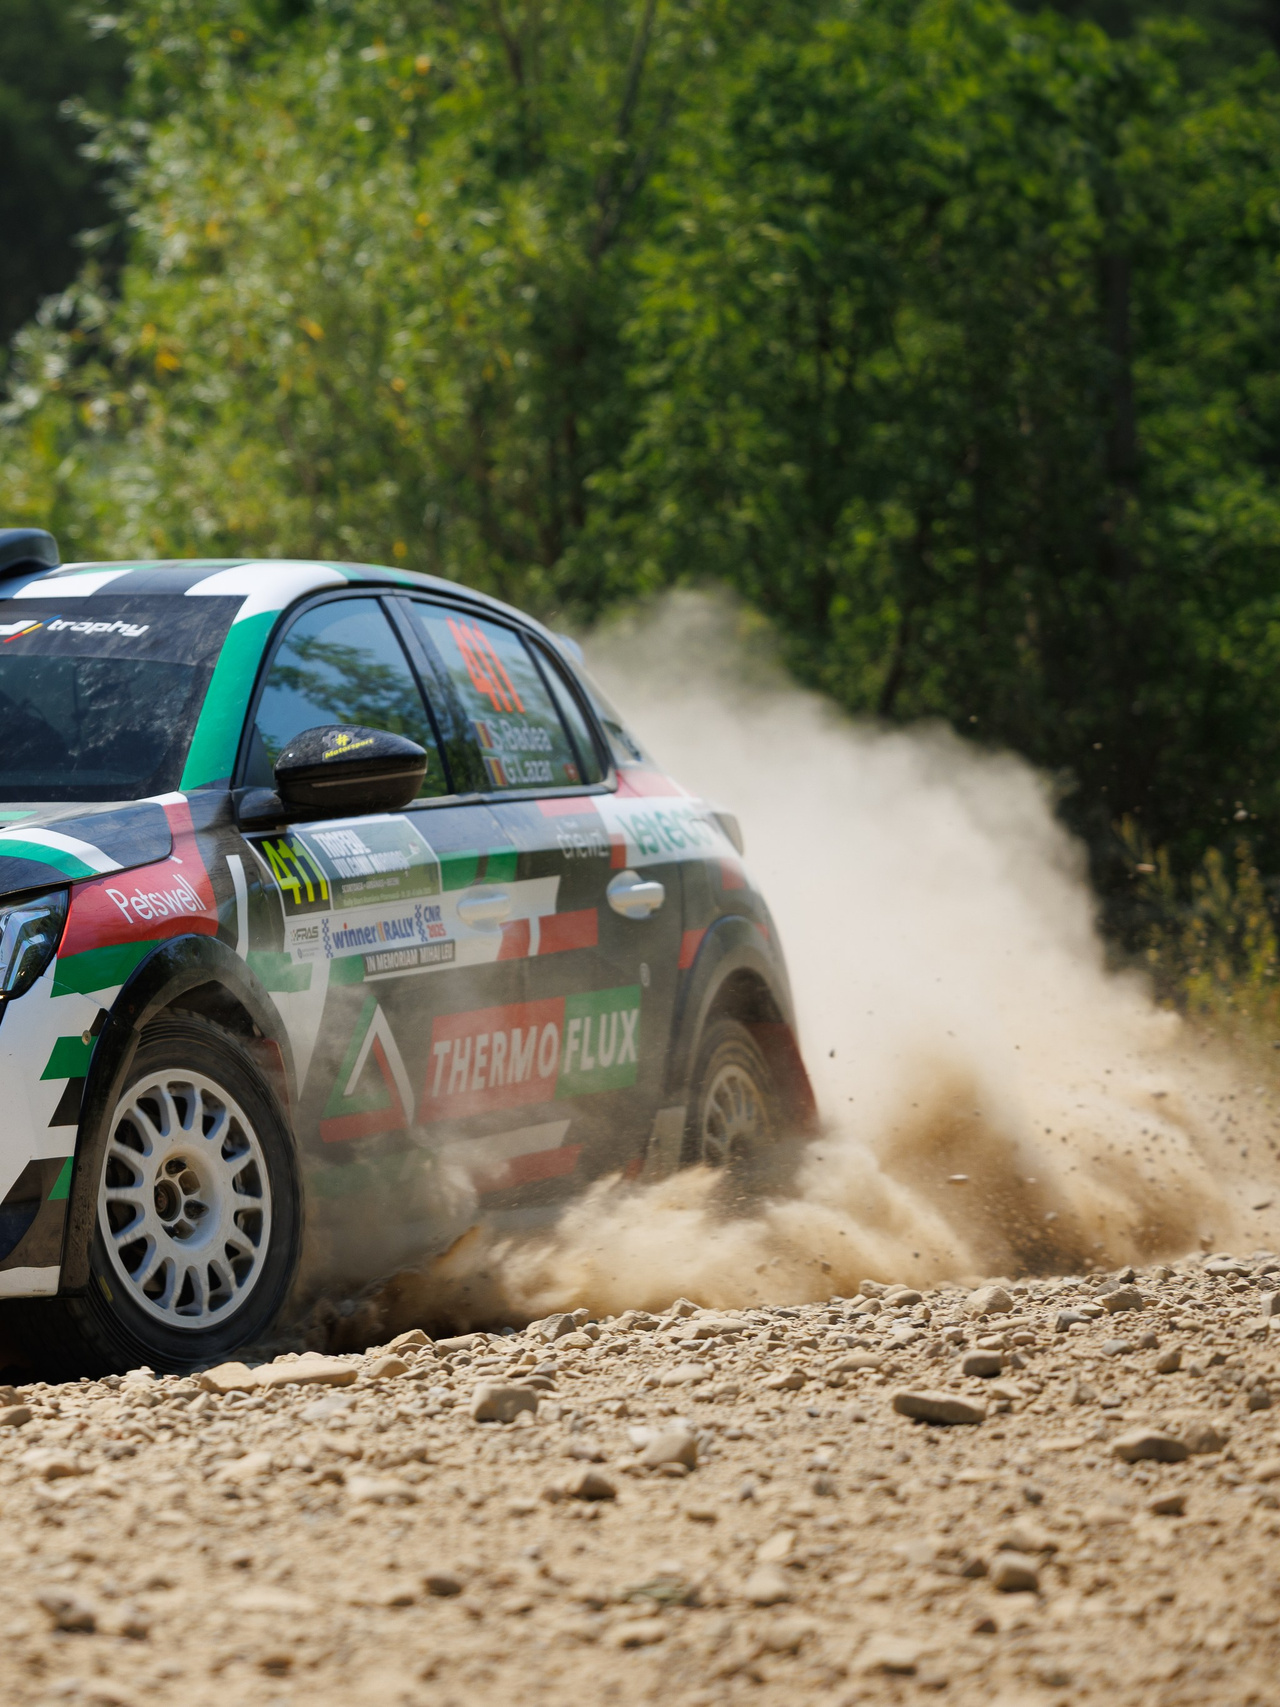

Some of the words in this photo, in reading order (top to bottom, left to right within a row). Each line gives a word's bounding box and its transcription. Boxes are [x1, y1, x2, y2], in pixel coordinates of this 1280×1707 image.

[47, 617, 150, 637] trophy
[324, 737, 375, 759] Motorsport
[486, 719, 553, 752] S.Badea
[501, 755, 555, 785] G.Lazar
[261, 837, 329, 905] 411
[105, 874, 206, 925] Petswell
[424, 905, 442, 922] CNR
[332, 922, 378, 949] winner
[382, 917, 416, 942] RALLY
[366, 955, 377, 972] IN
[376, 949, 418, 971] MEMORIAM
[432, 1021, 560, 1098] THERMO
[563, 1008, 640, 1075] FLUX
